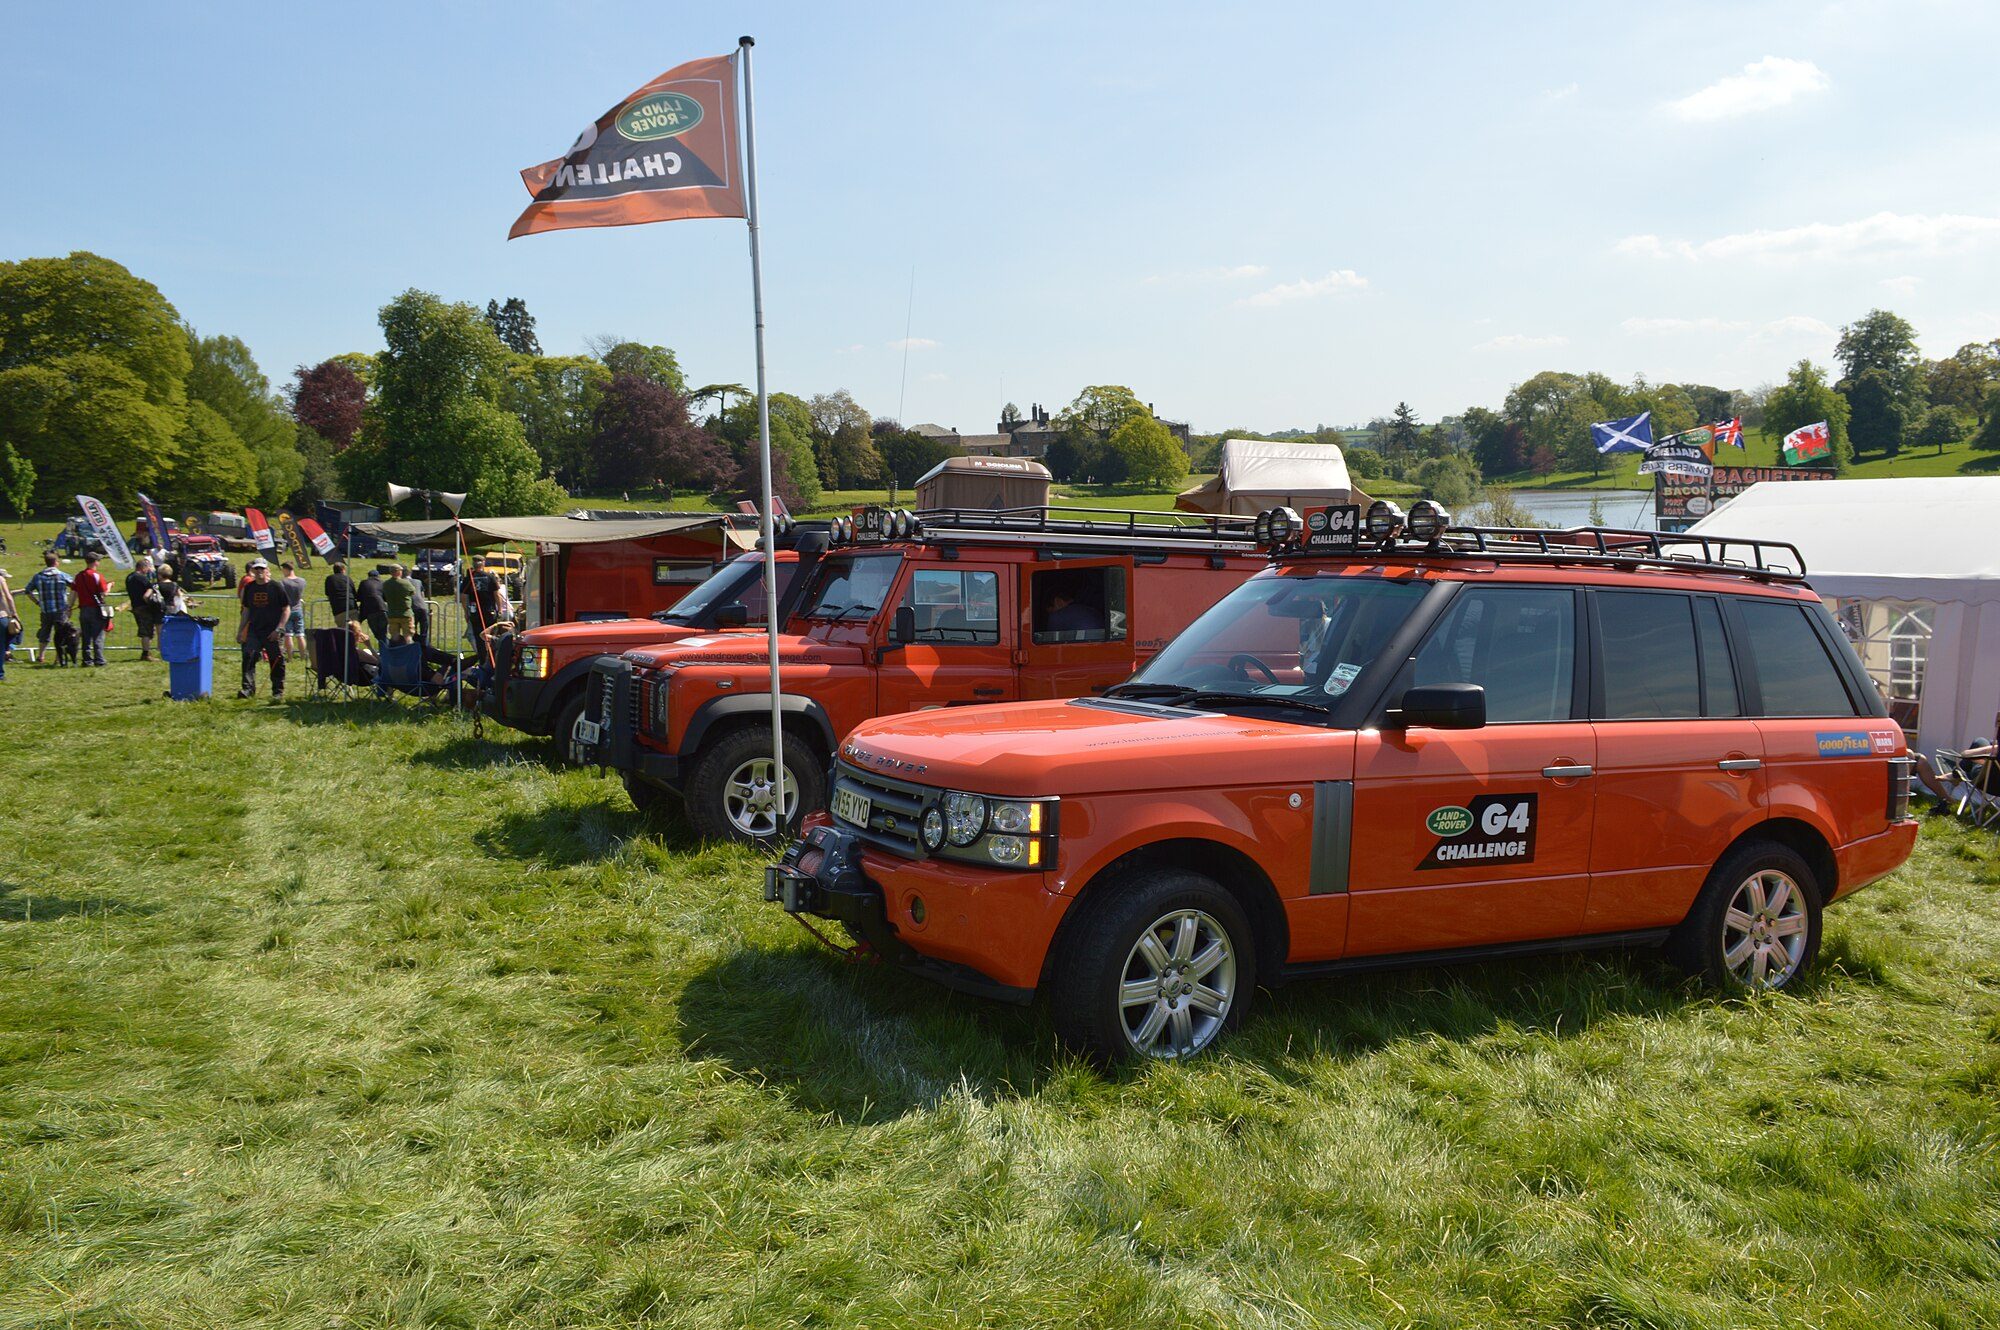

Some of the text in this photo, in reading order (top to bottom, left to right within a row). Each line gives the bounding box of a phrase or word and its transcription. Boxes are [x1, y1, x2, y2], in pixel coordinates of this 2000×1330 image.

[1713, 468, 1833, 484] BAGUETTES
[867, 512, 879, 529] G4
[1330, 510, 1354, 531] G4
[1311, 534, 1352, 545] CHALLENGE
[1820, 736, 1869, 752] GOODYEAR
[876, 756, 928, 774] ROVER
[1436, 811, 1460, 822] LAND
[1481, 802, 1530, 836] G4
[1438, 820, 1467, 830] ROVER
[1436, 841, 1527, 861] CHALLENGE
